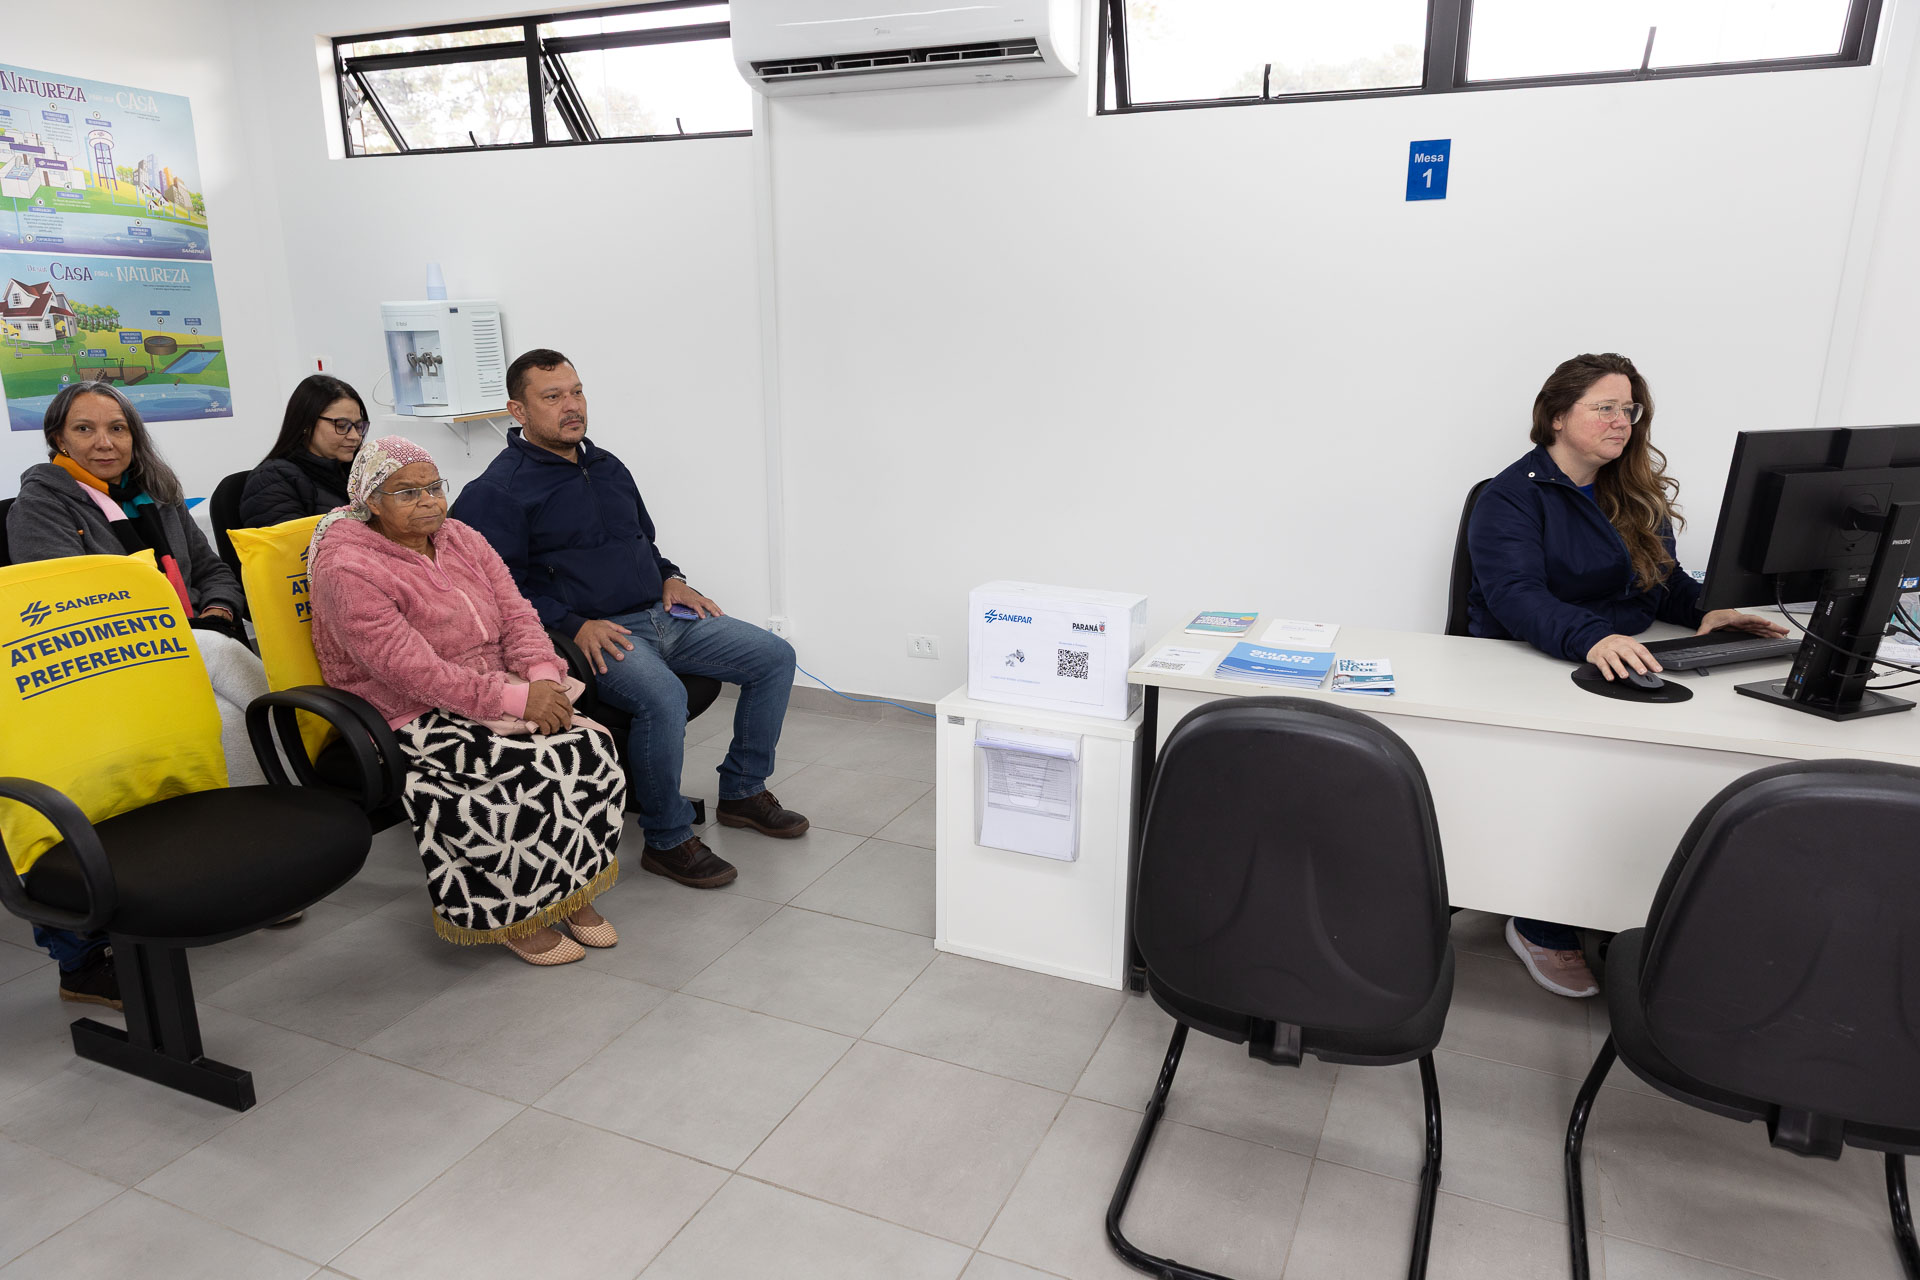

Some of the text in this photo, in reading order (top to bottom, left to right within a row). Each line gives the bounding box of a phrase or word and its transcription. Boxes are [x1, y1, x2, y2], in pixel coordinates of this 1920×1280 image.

[0, 71, 158, 113] NATUREZA CASA
[1414, 153, 1444, 163] Mesa
[1422, 168, 1432, 188] 1
[50, 262, 93, 281] CASA
[116, 266, 191, 283] NATUREZA
[55, 590, 131, 613] SANEPAR
[998, 613, 1033, 624] SANEPAR
[1072, 622, 1099, 632] PARANÁ
[10, 613, 177, 667] ATENDIMENTO
[15, 637, 188, 694] PREFERENCIAL
[1249, 653, 1311, 664] CLIENTE
